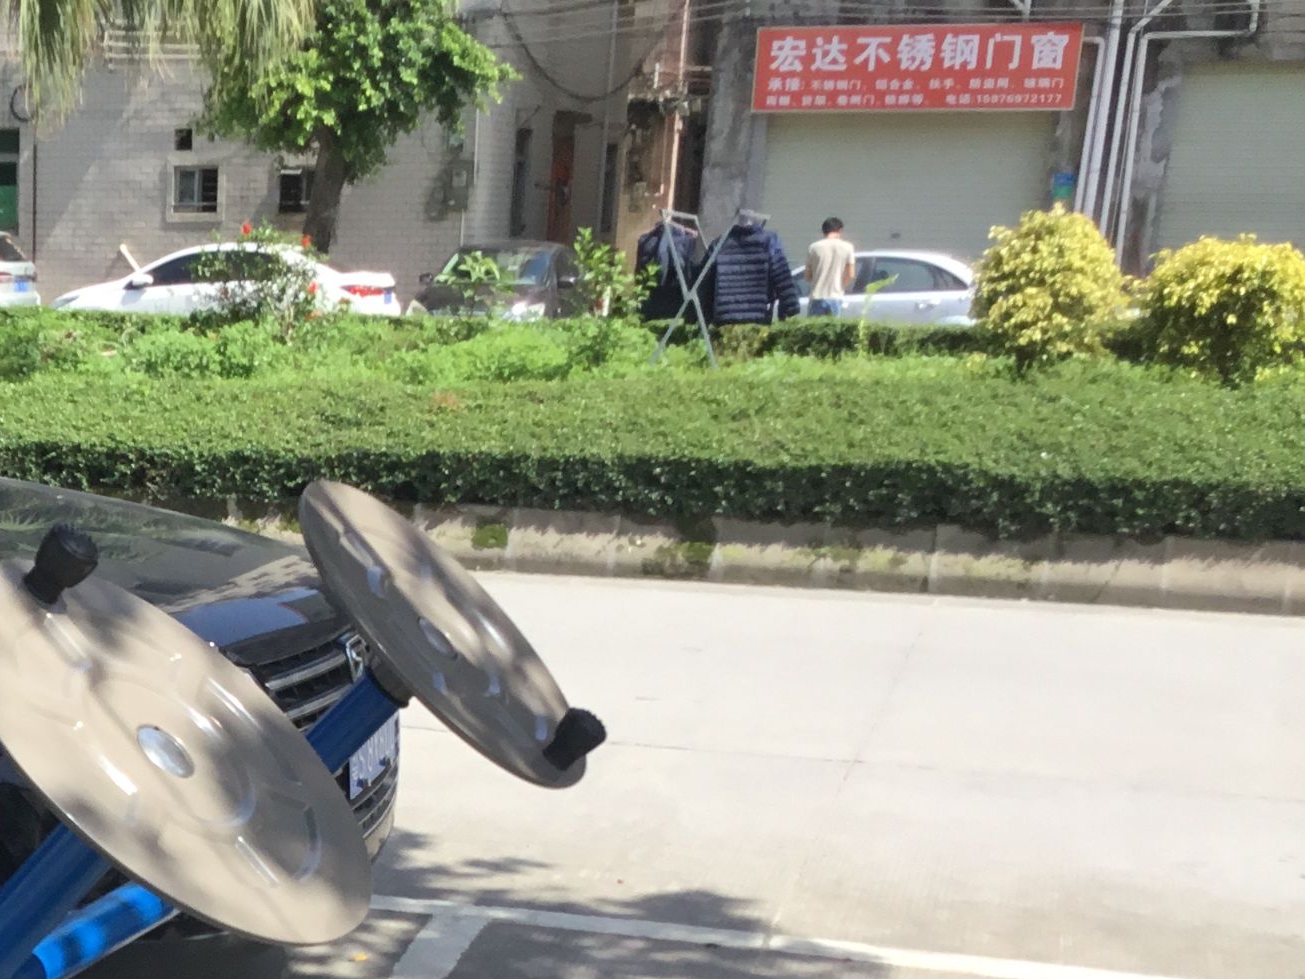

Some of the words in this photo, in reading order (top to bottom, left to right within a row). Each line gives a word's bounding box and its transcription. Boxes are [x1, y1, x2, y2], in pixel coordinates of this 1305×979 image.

[769, 32, 1069, 73] 宏达不锈钢门窗
